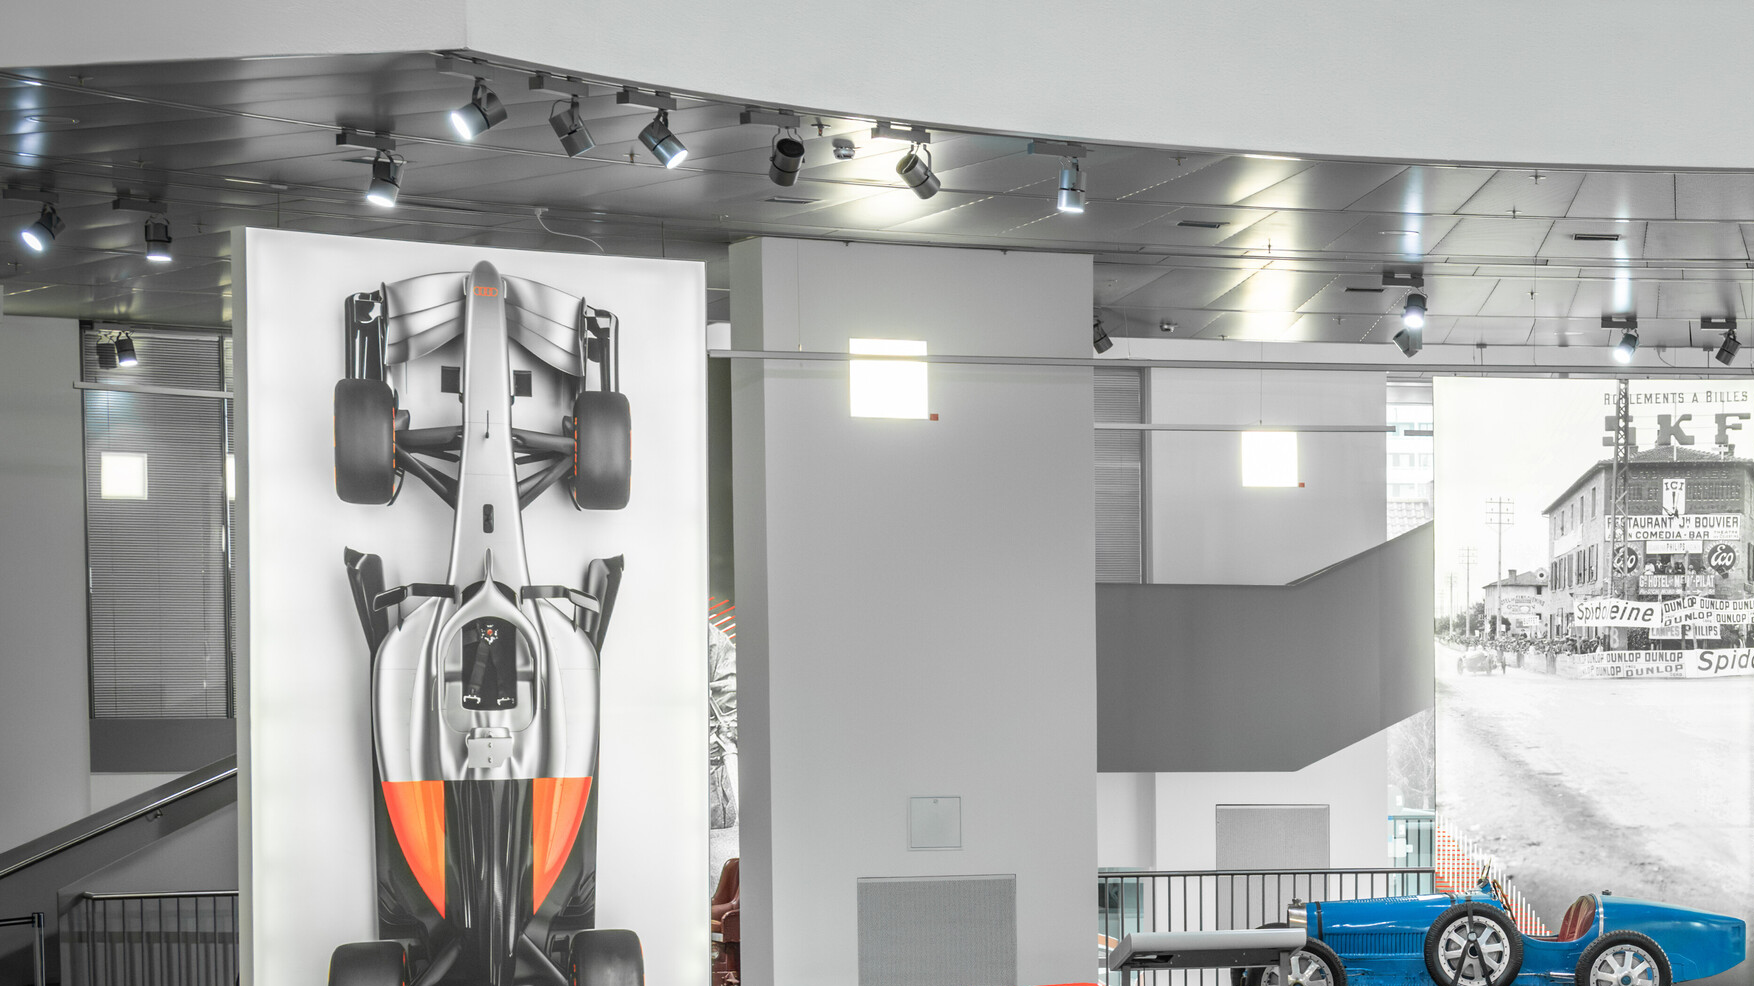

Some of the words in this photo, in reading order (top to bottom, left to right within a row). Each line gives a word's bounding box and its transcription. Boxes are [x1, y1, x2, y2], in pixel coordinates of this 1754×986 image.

[1604, 392, 1684, 405] ROLEMENTS
[1691, 392, 1699, 404] A
[1706, 390, 1748, 403] BILLES
[1664, 481, 1684, 491] ICI
[1695, 516, 1739, 528] BOUVIER
[1664, 597, 1696, 613] DUNLOP
[1700, 599, 1730, 610] DUNLOP
[1665, 612, 1713, 626] DUNLOP
[1716, 613, 1747, 623] DUNLOP
[1607, 652, 1641, 663] DUNLOP
[1645, 651, 1683, 662] DUNLOP
[1626, 664, 1683, 677] DUNLOP
